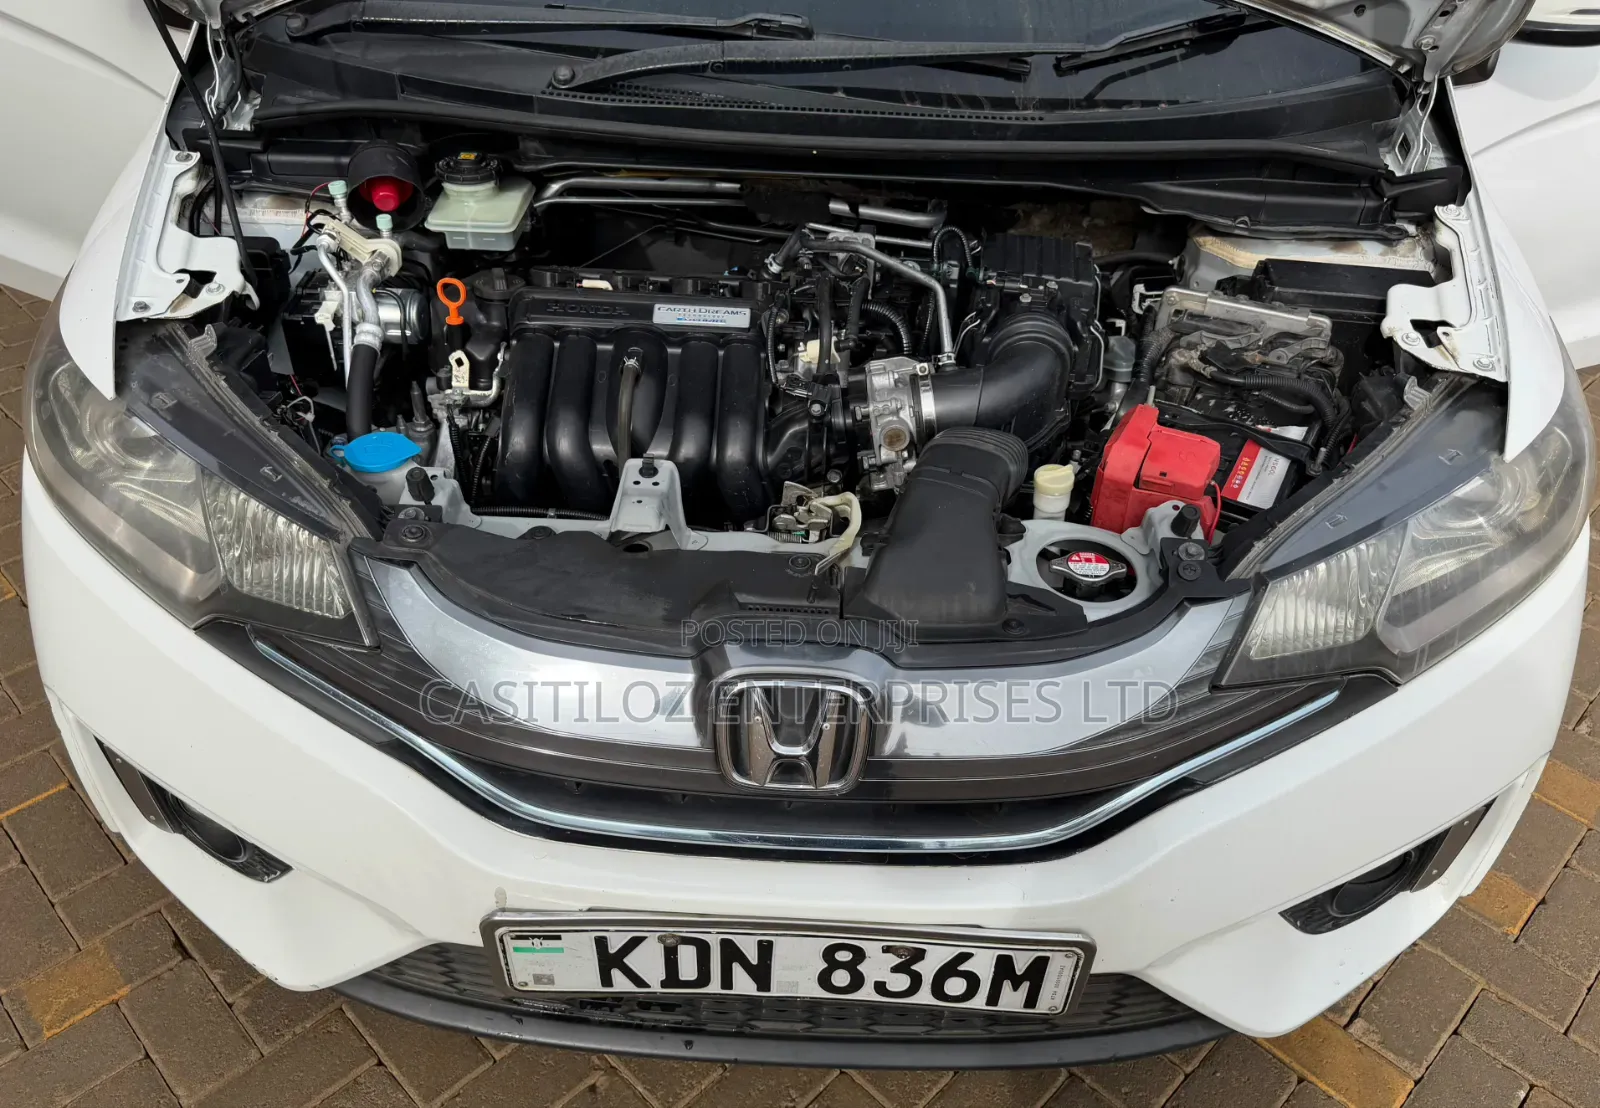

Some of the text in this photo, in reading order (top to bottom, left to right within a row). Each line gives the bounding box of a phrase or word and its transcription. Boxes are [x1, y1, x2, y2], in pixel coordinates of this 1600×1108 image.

[546, 302, 630, 316] HONDA
[699, 307, 747, 316] DREAMS
[594, 935, 1051, 1009] KDN 836M
